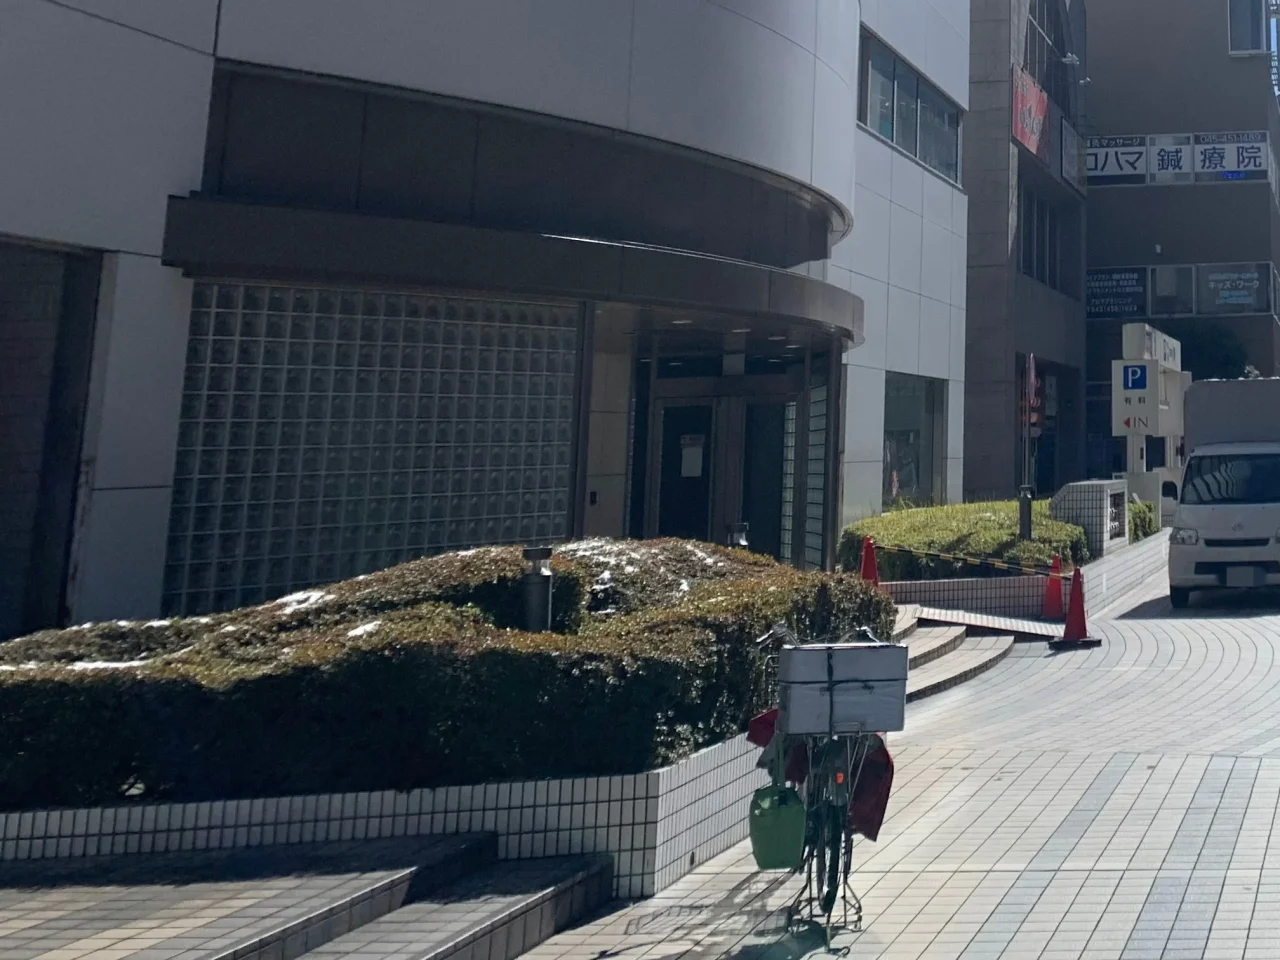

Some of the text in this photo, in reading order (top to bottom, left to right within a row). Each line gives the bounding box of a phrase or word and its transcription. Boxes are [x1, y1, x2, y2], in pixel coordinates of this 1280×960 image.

[1128, 367, 1141, 388] P
[1125, 396, 1146, 405] 有料
[1134, 417, 1148, 428] IN
